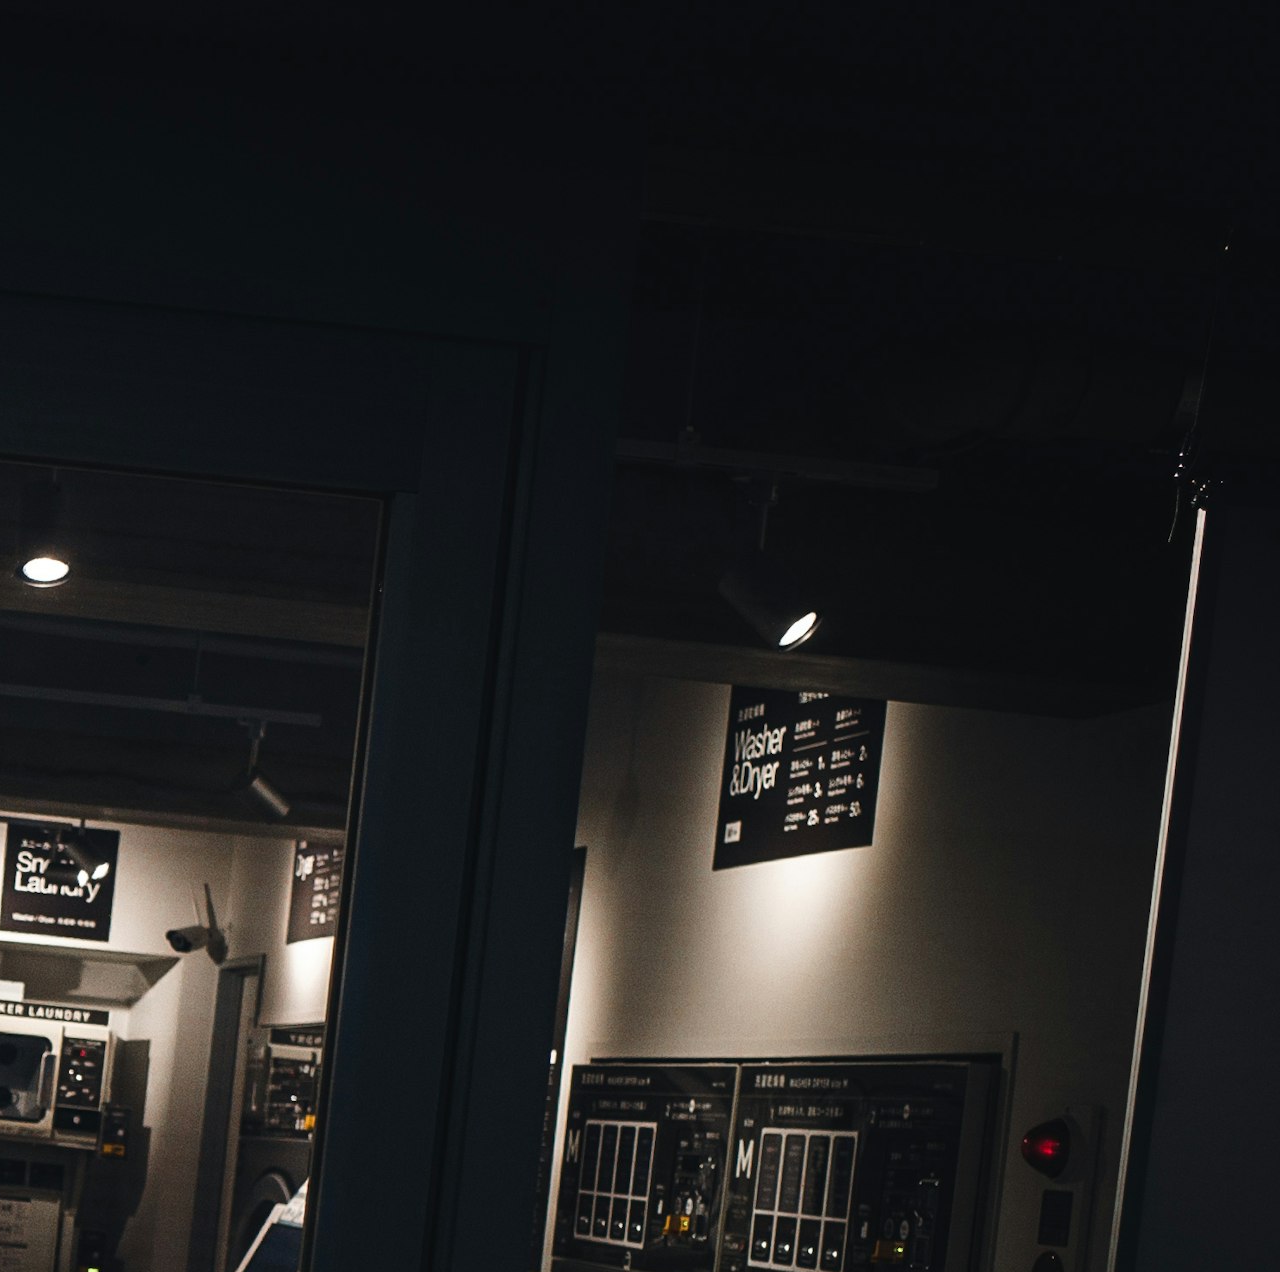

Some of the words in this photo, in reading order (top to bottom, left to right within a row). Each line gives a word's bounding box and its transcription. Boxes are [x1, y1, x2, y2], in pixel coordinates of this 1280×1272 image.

[735, 723, 787, 762] Washer
[28, 1004, 91, 1023] LAUNDRY
[565, 1128, 582, 1163] M
[735, 1138, 755, 1180] M
